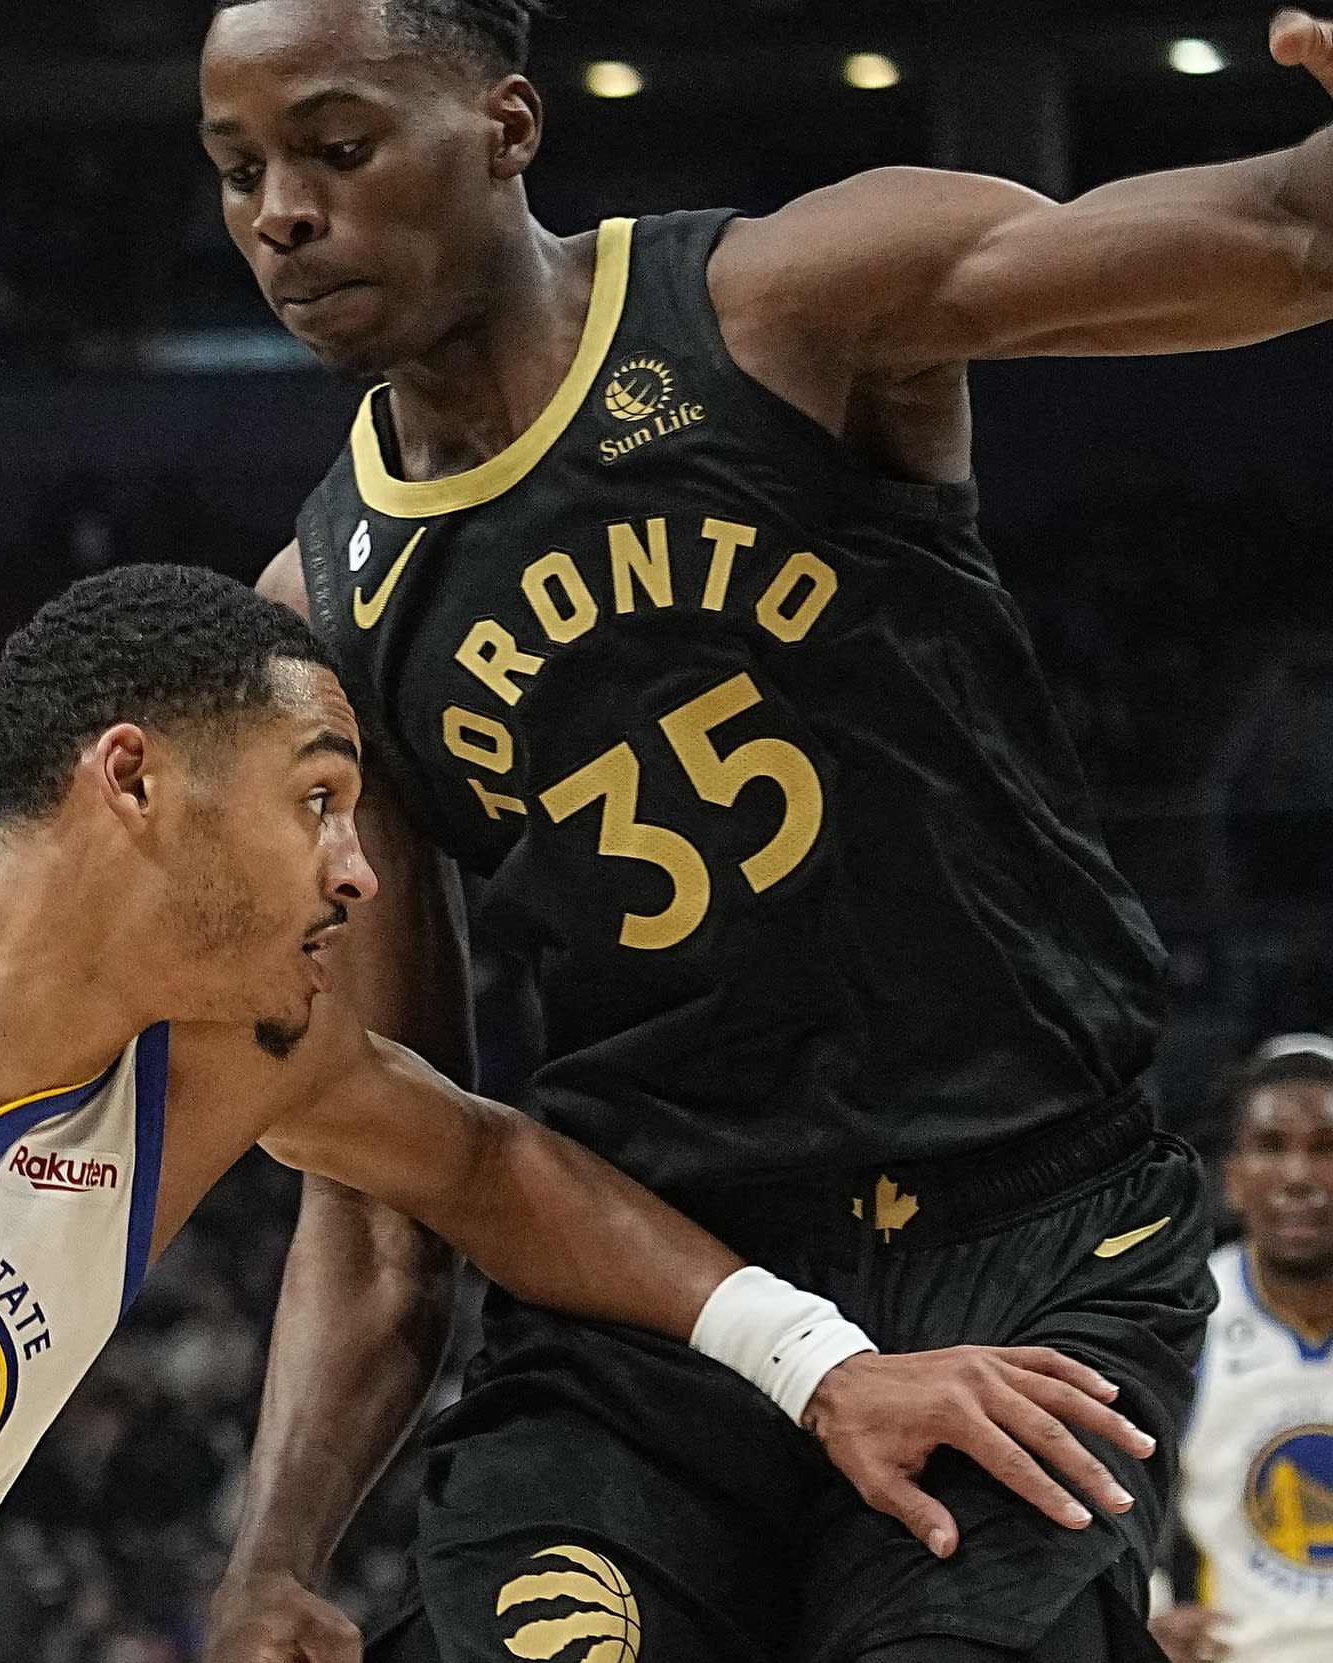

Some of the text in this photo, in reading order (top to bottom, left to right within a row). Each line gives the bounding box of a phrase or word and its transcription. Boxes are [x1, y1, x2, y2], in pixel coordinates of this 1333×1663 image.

[600, 400, 706, 464] Sun Life
[349, 520, 371, 571] 6
[442, 517, 838, 820] TORONTO
[538, 671, 824, 950] 35
[9, 1145, 118, 1190] Rakuten
